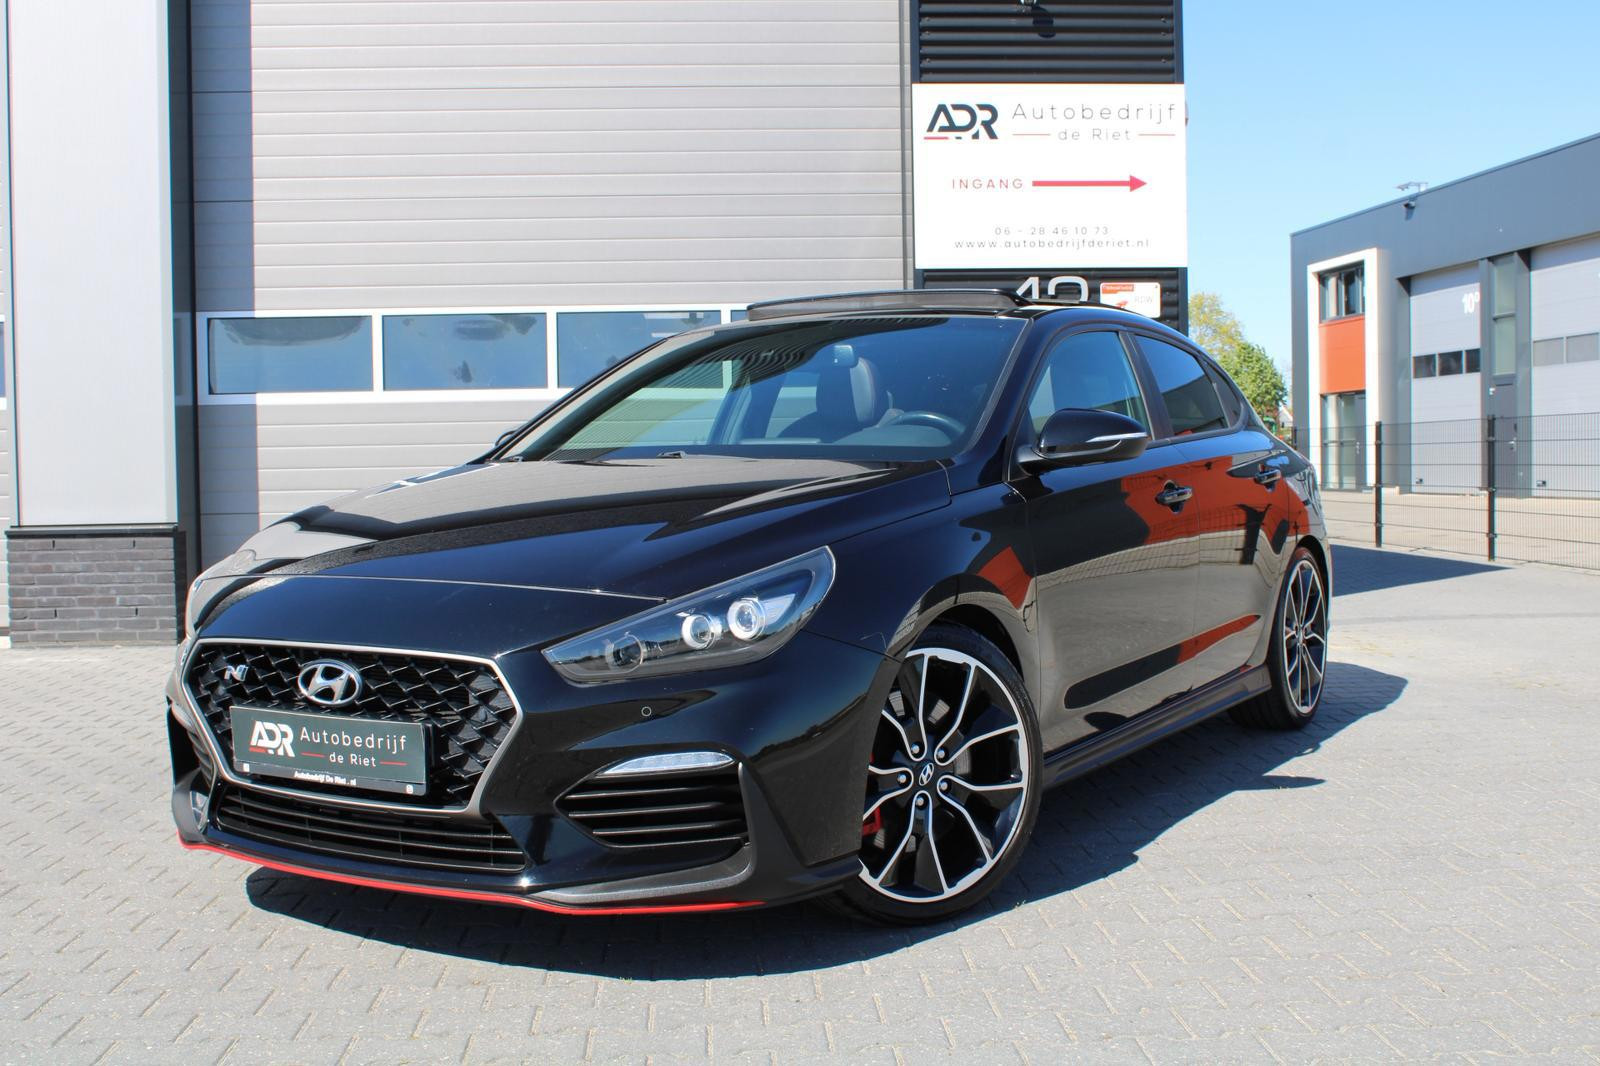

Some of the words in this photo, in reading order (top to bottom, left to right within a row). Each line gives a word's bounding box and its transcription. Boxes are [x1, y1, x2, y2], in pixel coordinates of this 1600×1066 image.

[926, 103, 999, 140] ADR
[1012, 103, 1175, 124] Autobedrijf
[1058, 128, 1081, 140] de
[1092, 128, 1131, 140] Riet
[952, 178, 1024, 189] INGANG
[994, 226, 1011, 235] 06
[1031, 226, 1046, 235] 28
[1052, 226, 1068, 235] 46
[1074, 226, 1088, 235] 10
[1095, 226, 1109, 235] 73
[250, 720, 295, 757] ADR
[300, 726, 407, 755] Autobedrijf
[329, 751, 344, 764] de
[350, 754, 377, 767] Riet
[294, 770, 325, 783] Autobedrijf
